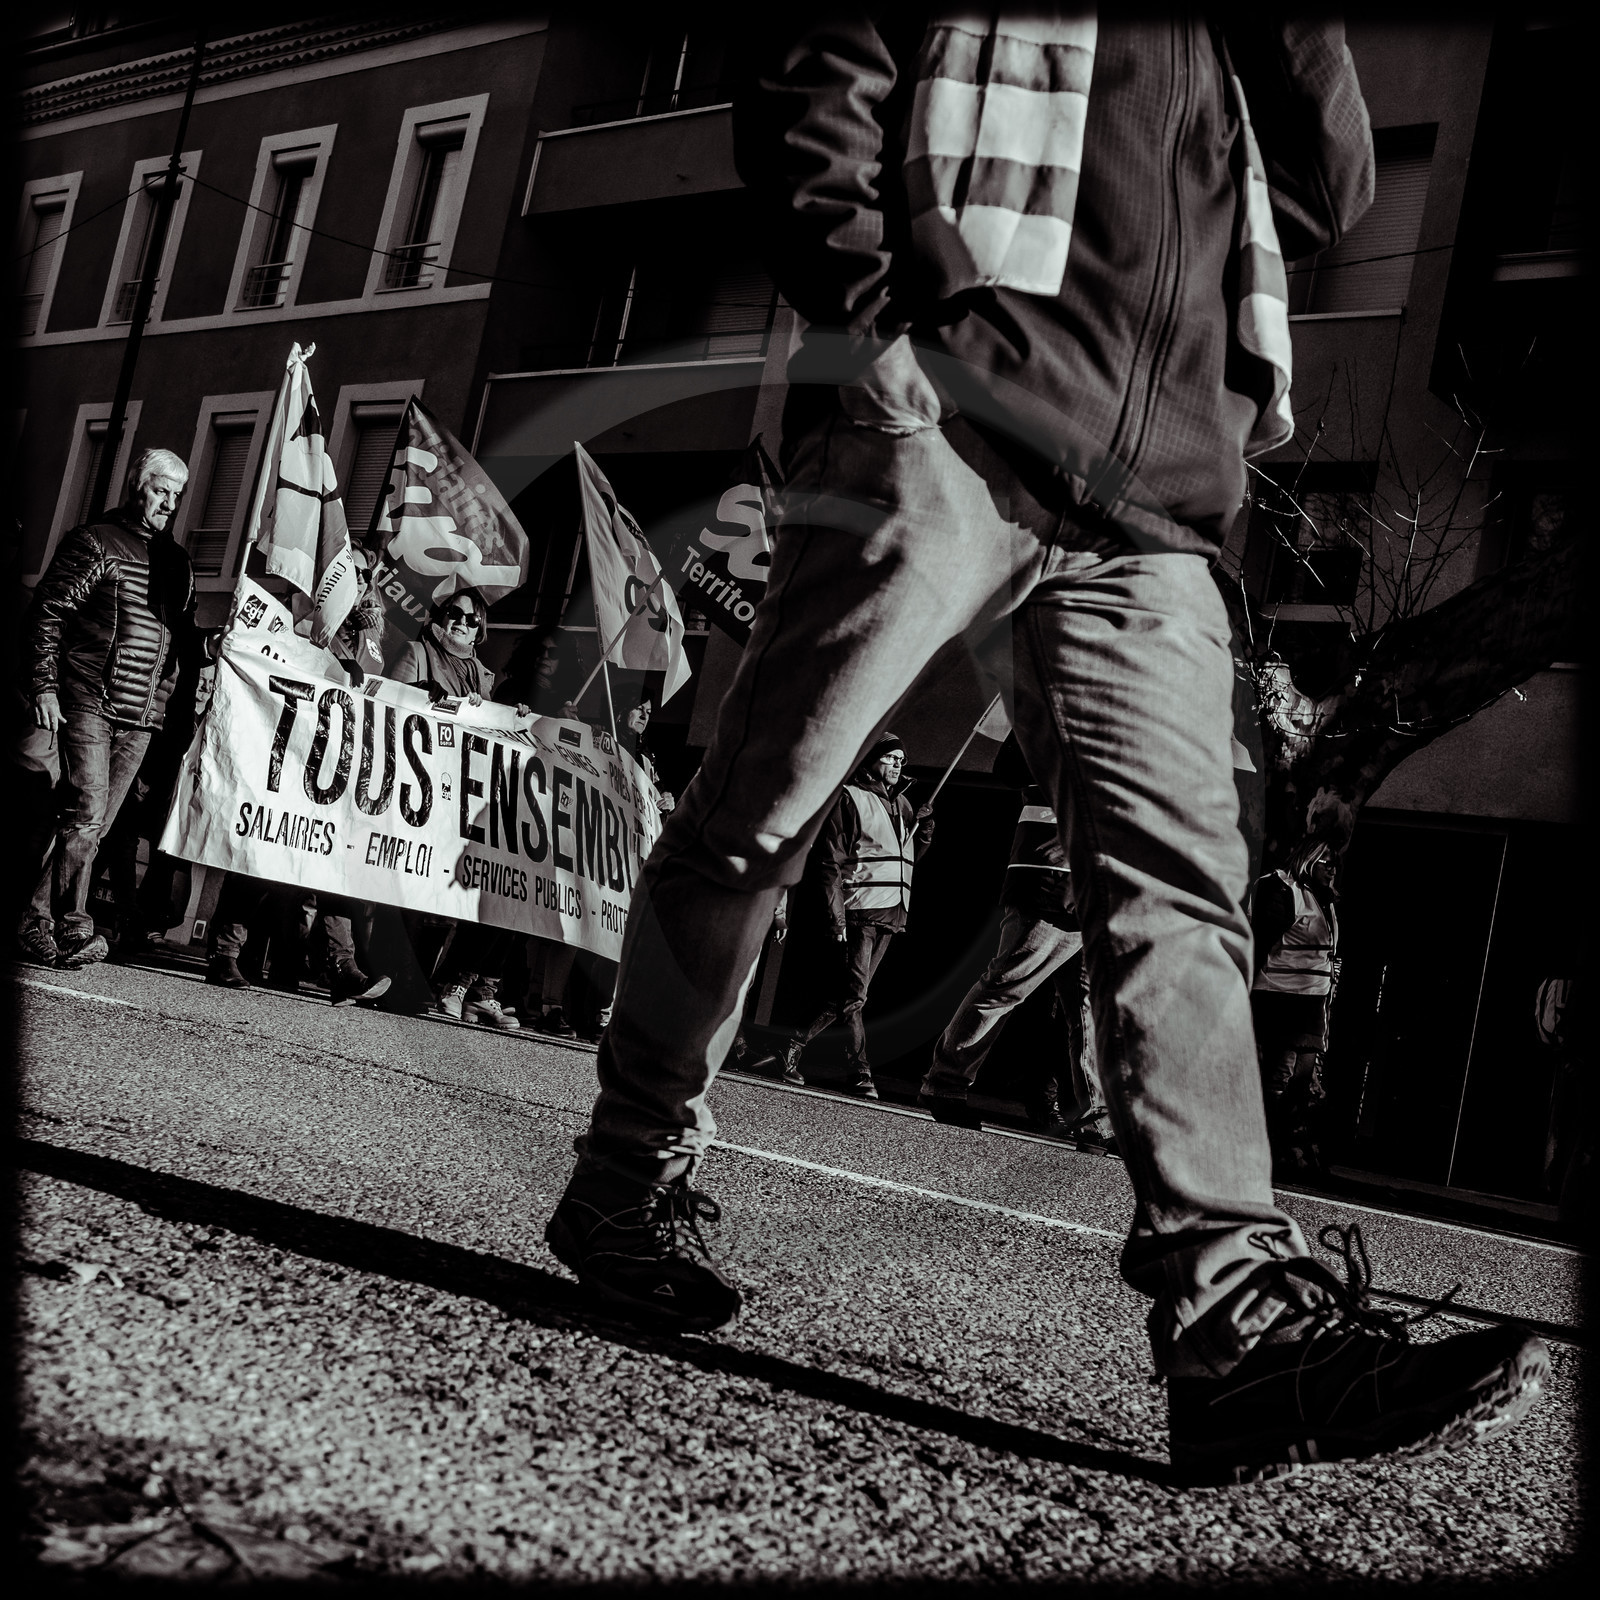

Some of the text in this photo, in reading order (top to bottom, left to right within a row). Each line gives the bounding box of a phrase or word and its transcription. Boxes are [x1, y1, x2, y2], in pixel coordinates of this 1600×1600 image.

[681, 545, 757, 630] Territo
[266, 674, 434, 828] TOUS
[440, 725, 453, 742] FO
[235, 801, 336, 856] SALAIRES
[364, 831, 434, 878] EMPLOI
[462, 854, 528, 902] SERVICES
[535, 875, 582, 920] PUBLICS
